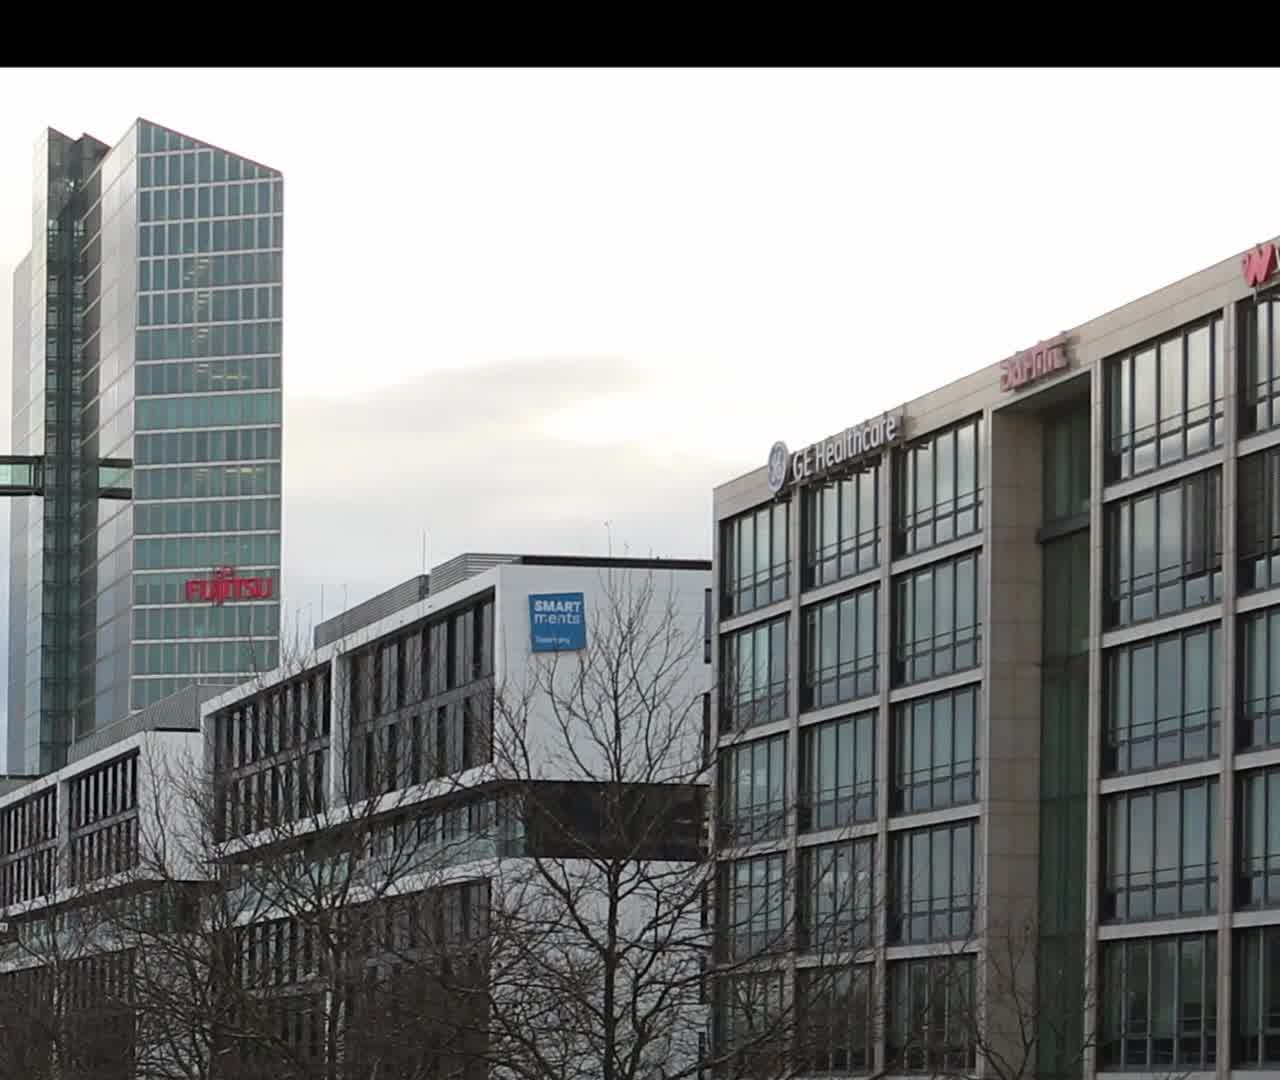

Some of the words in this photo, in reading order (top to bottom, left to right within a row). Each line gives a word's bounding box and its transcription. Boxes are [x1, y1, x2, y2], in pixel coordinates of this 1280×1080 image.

[793, 448, 813, 481] GE
[815, 414, 897, 474] Healthcare
[186, 570, 272, 604] FUJITSU
[534, 599, 582, 613] SMART
